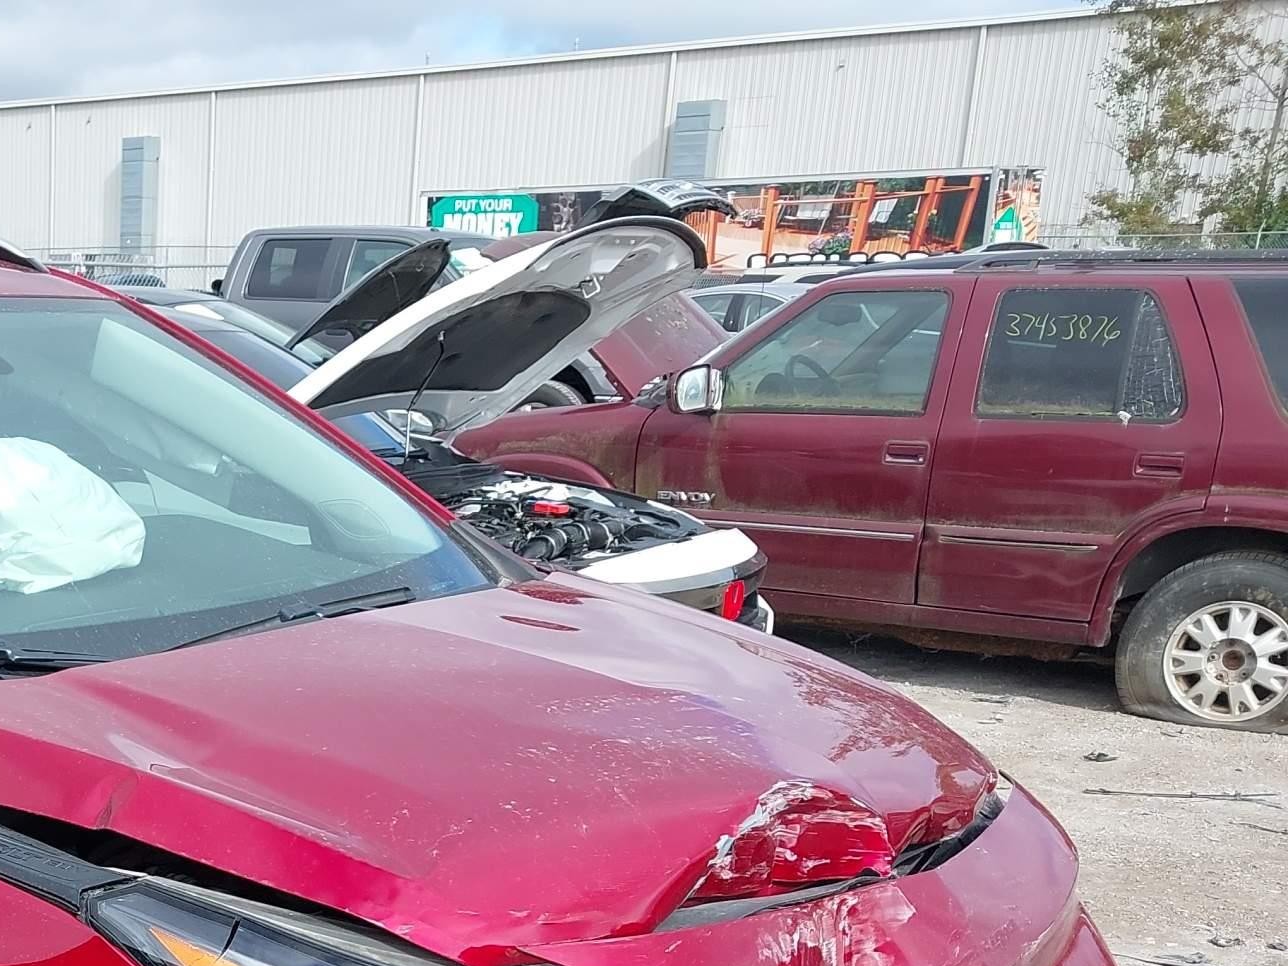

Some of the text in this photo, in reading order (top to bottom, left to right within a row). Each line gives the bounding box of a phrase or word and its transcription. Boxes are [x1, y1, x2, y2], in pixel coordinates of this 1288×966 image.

[454, 198, 513, 212] PUT YOUR
[443, 212, 523, 239] MONEY
[1005, 312, 1121, 347] 37453876
[657, 490, 716, 504] ENVOY
